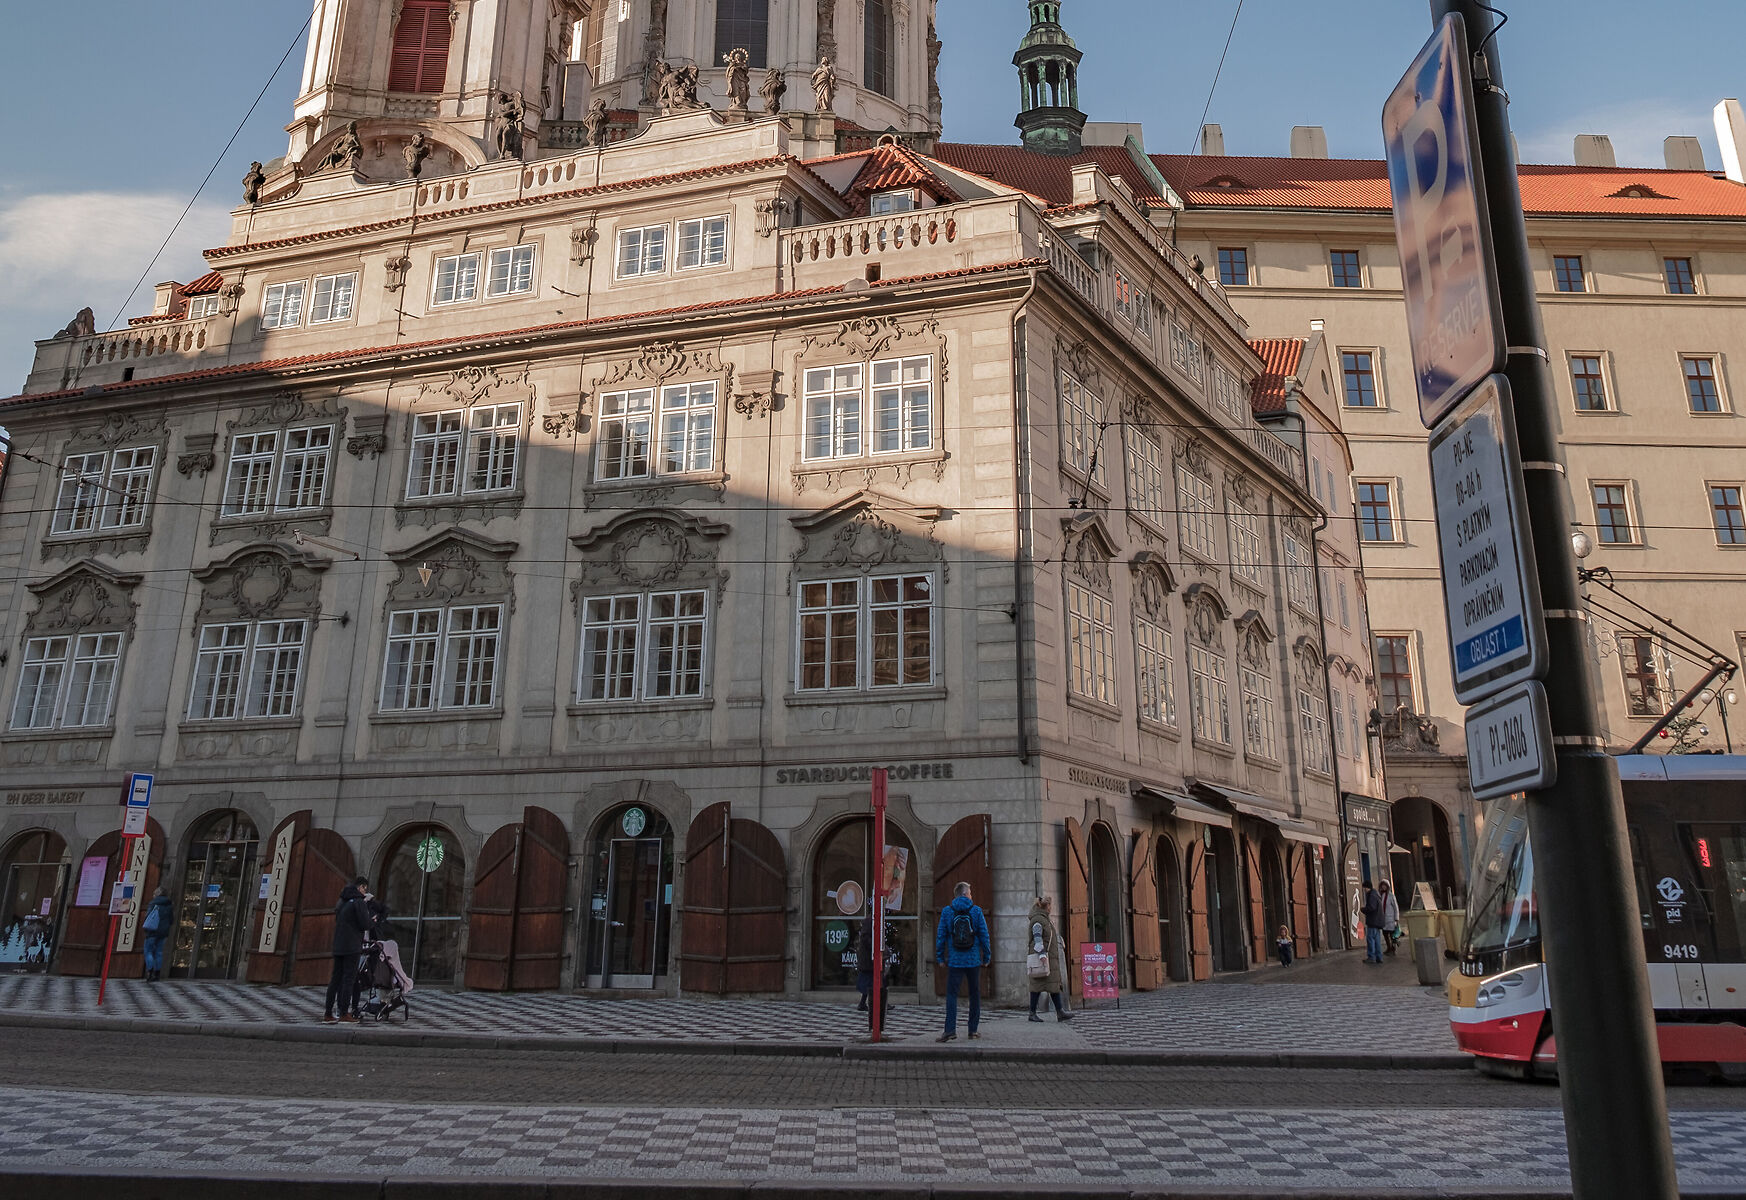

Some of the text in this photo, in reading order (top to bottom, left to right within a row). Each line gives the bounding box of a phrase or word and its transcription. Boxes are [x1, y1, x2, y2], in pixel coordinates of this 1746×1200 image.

[1402, 99, 1448, 302] P
[1453, 430, 1474, 467] PO-NE
[1455, 471, 1475, 506] 08-06
[1457, 499, 1492, 548] S PLATNÝM
[1459, 537, 1499, 588] PARKOVACÍM
[1463, 578, 1505, 628] OPRÁVNĚNÍM
[1470, 626, 1508, 663] OBLAST 1
[1489, 713, 1528, 768] P1-0606
[776, 763, 953, 784] STARBUCK COFFEE
[122, 839, 146, 946] ANTIQUE
[263, 836, 288, 946] ANTIQUE
[1666, 908, 1681, 919] pid
[825, 930, 841, 944] 139
[1663, 944, 1699, 959] 9419
[1461, 961, 1484, 976] 9419
